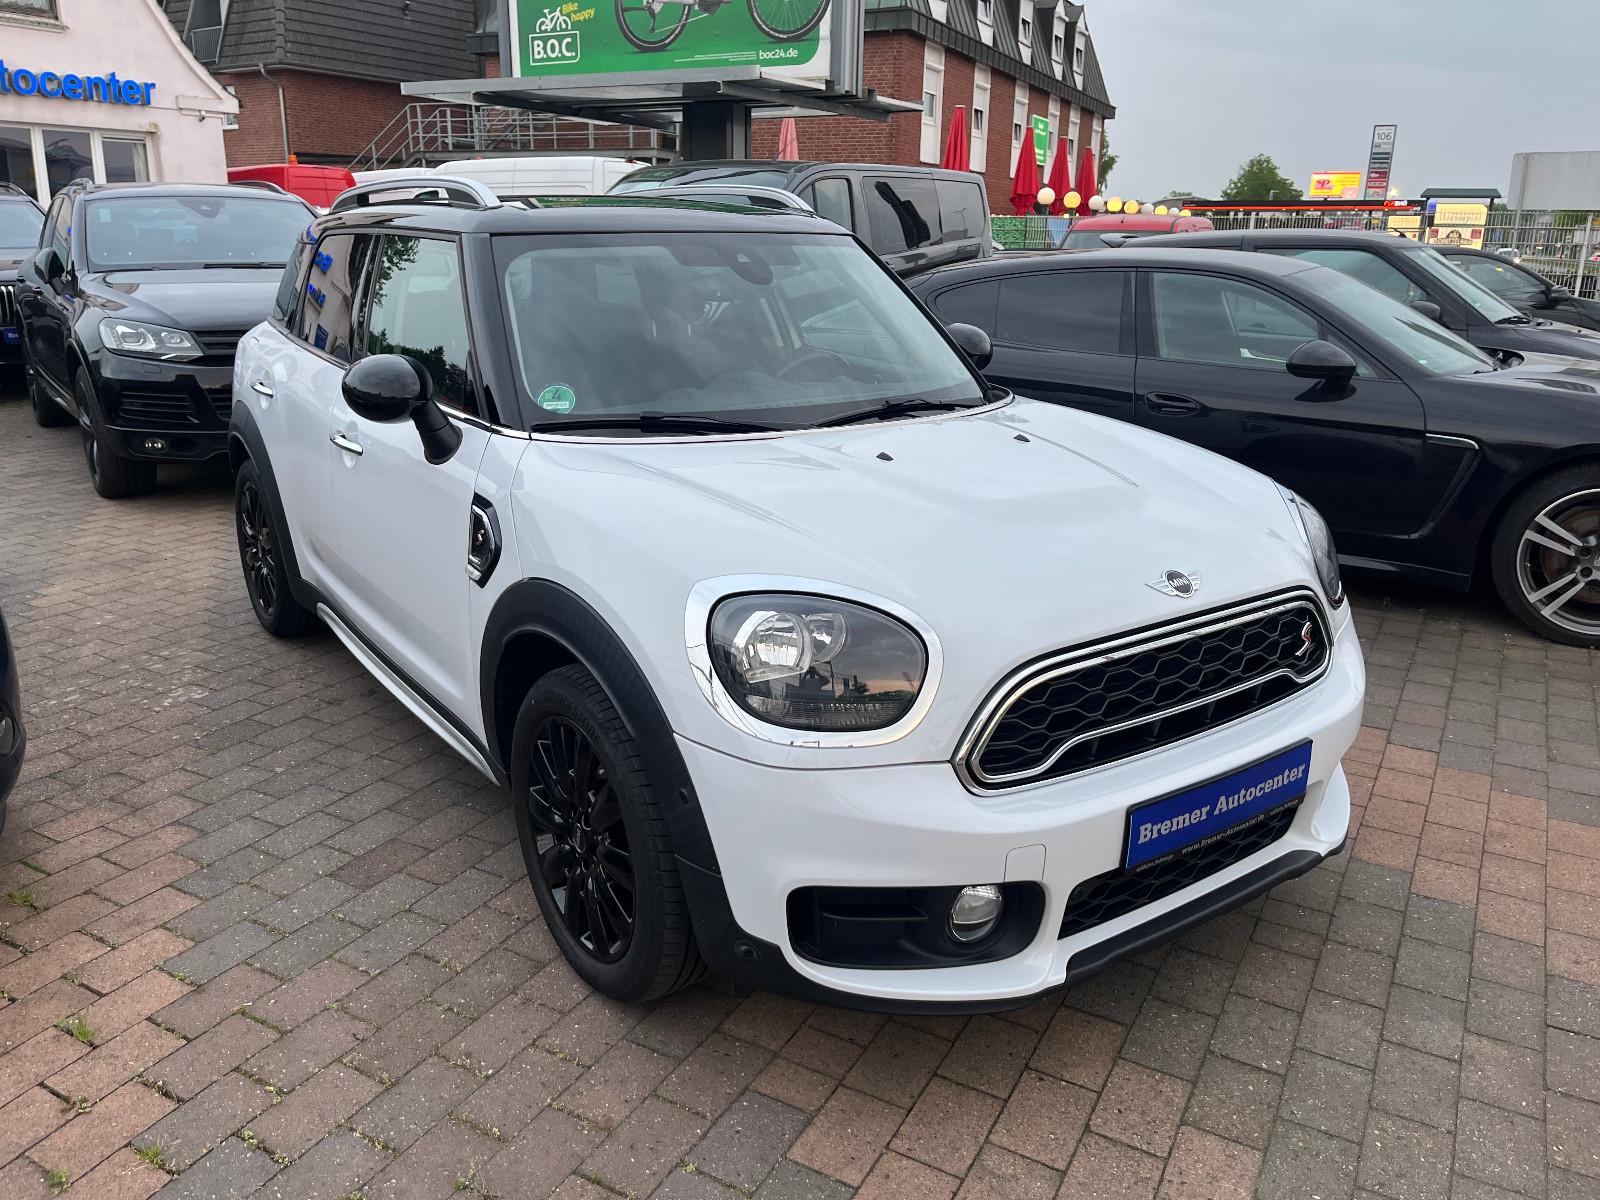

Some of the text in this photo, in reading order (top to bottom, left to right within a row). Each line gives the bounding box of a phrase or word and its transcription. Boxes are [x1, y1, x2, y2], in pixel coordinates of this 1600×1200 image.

[562, 2, 578, 14] Bike
[571, 8, 595, 21] happy
[533, 37, 576, 59] B.O.C.
[758, 47, 798, 59] boc24.de
[1377, 132, 1392, 141] 106
[552, 388, 562, 400] 4
[1169, 576, 1190, 588] MINI
[1138, 763, 1306, 844] Bremer Autocenter
